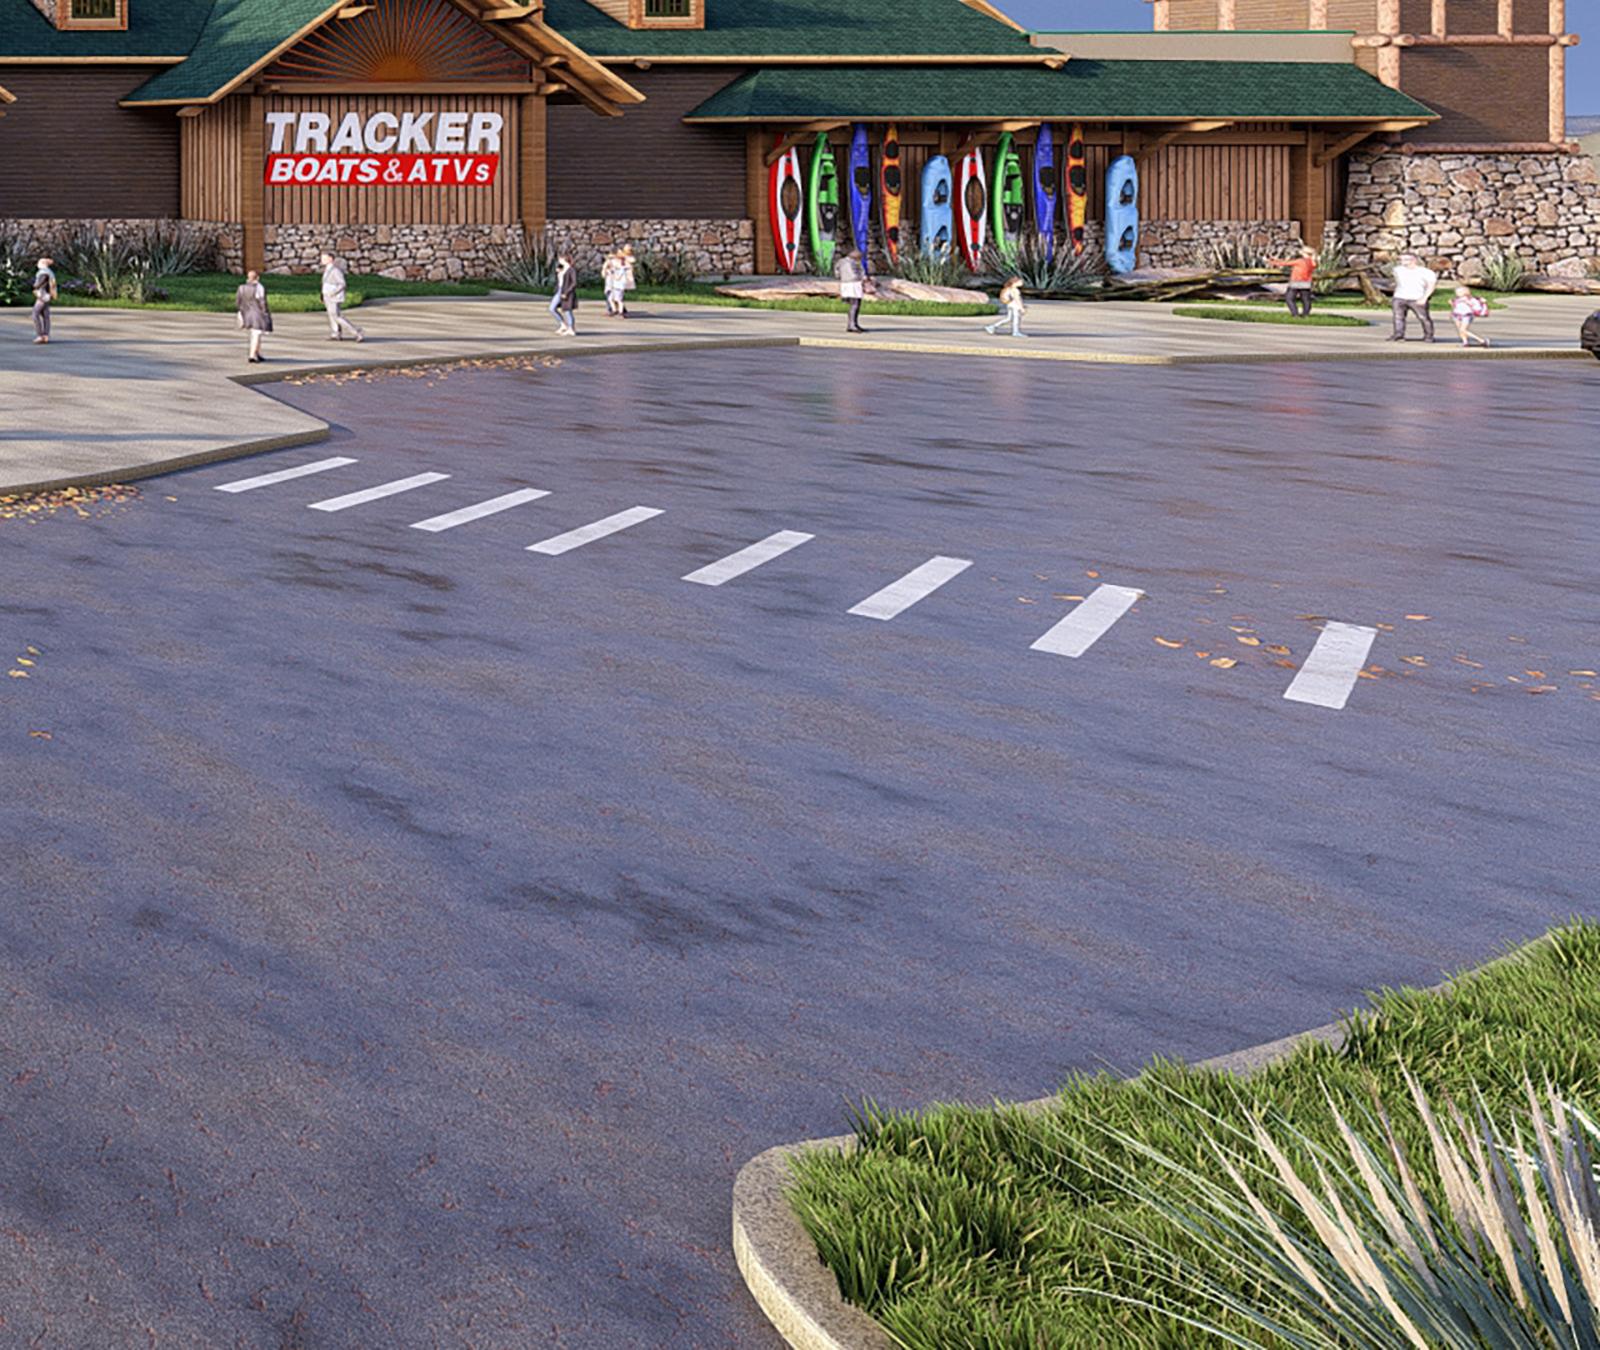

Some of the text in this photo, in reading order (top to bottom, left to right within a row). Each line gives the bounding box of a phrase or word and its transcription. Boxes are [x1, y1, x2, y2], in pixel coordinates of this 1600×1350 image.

[265, 111, 503, 152] TRACKER
[270, 158, 381, 183] BOATS
[382, 158, 404, 182] &
